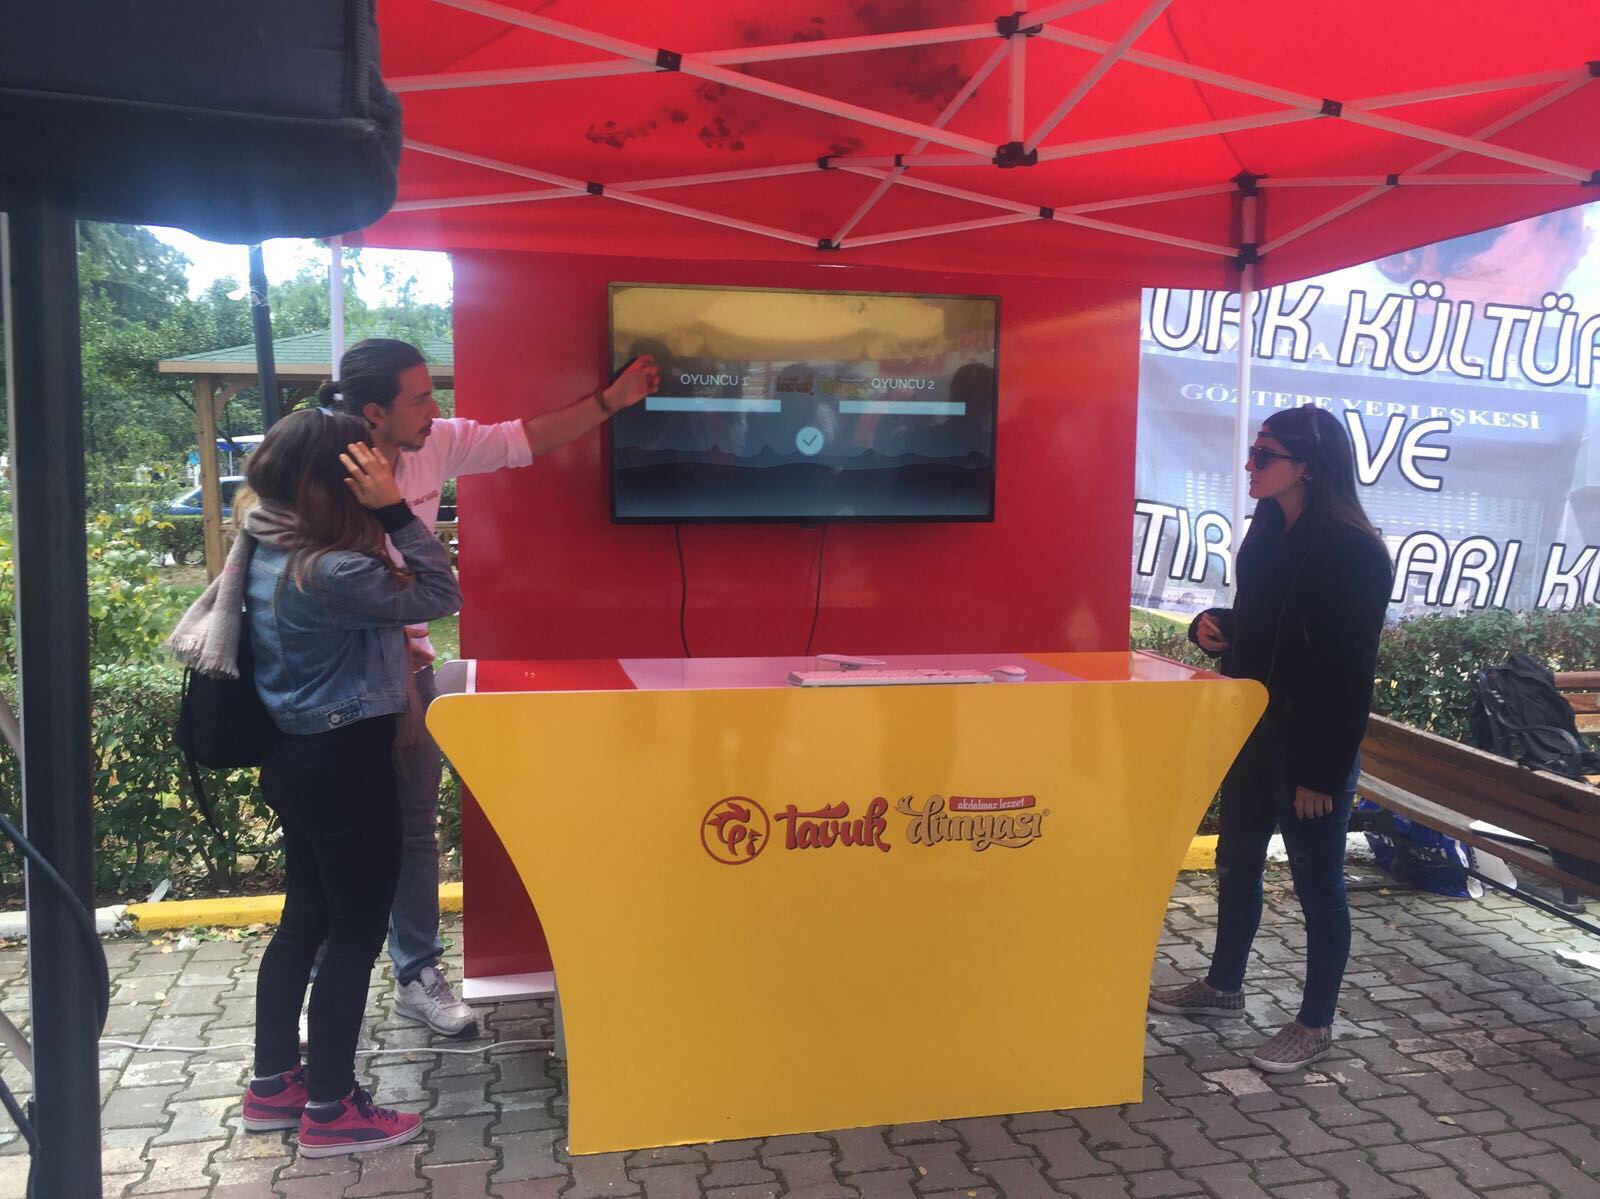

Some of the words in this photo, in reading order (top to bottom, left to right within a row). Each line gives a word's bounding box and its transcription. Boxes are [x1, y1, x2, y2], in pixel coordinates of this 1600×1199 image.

[680, 373, 739, 386] OYUNCU
[742, 377, 748, 386] 1
[871, 377, 924, 390] OYUNCU
[927, 380, 935, 390] 2
[1344, 409, 1452, 492] VE
[773, 796, 892, 853] tavuk
